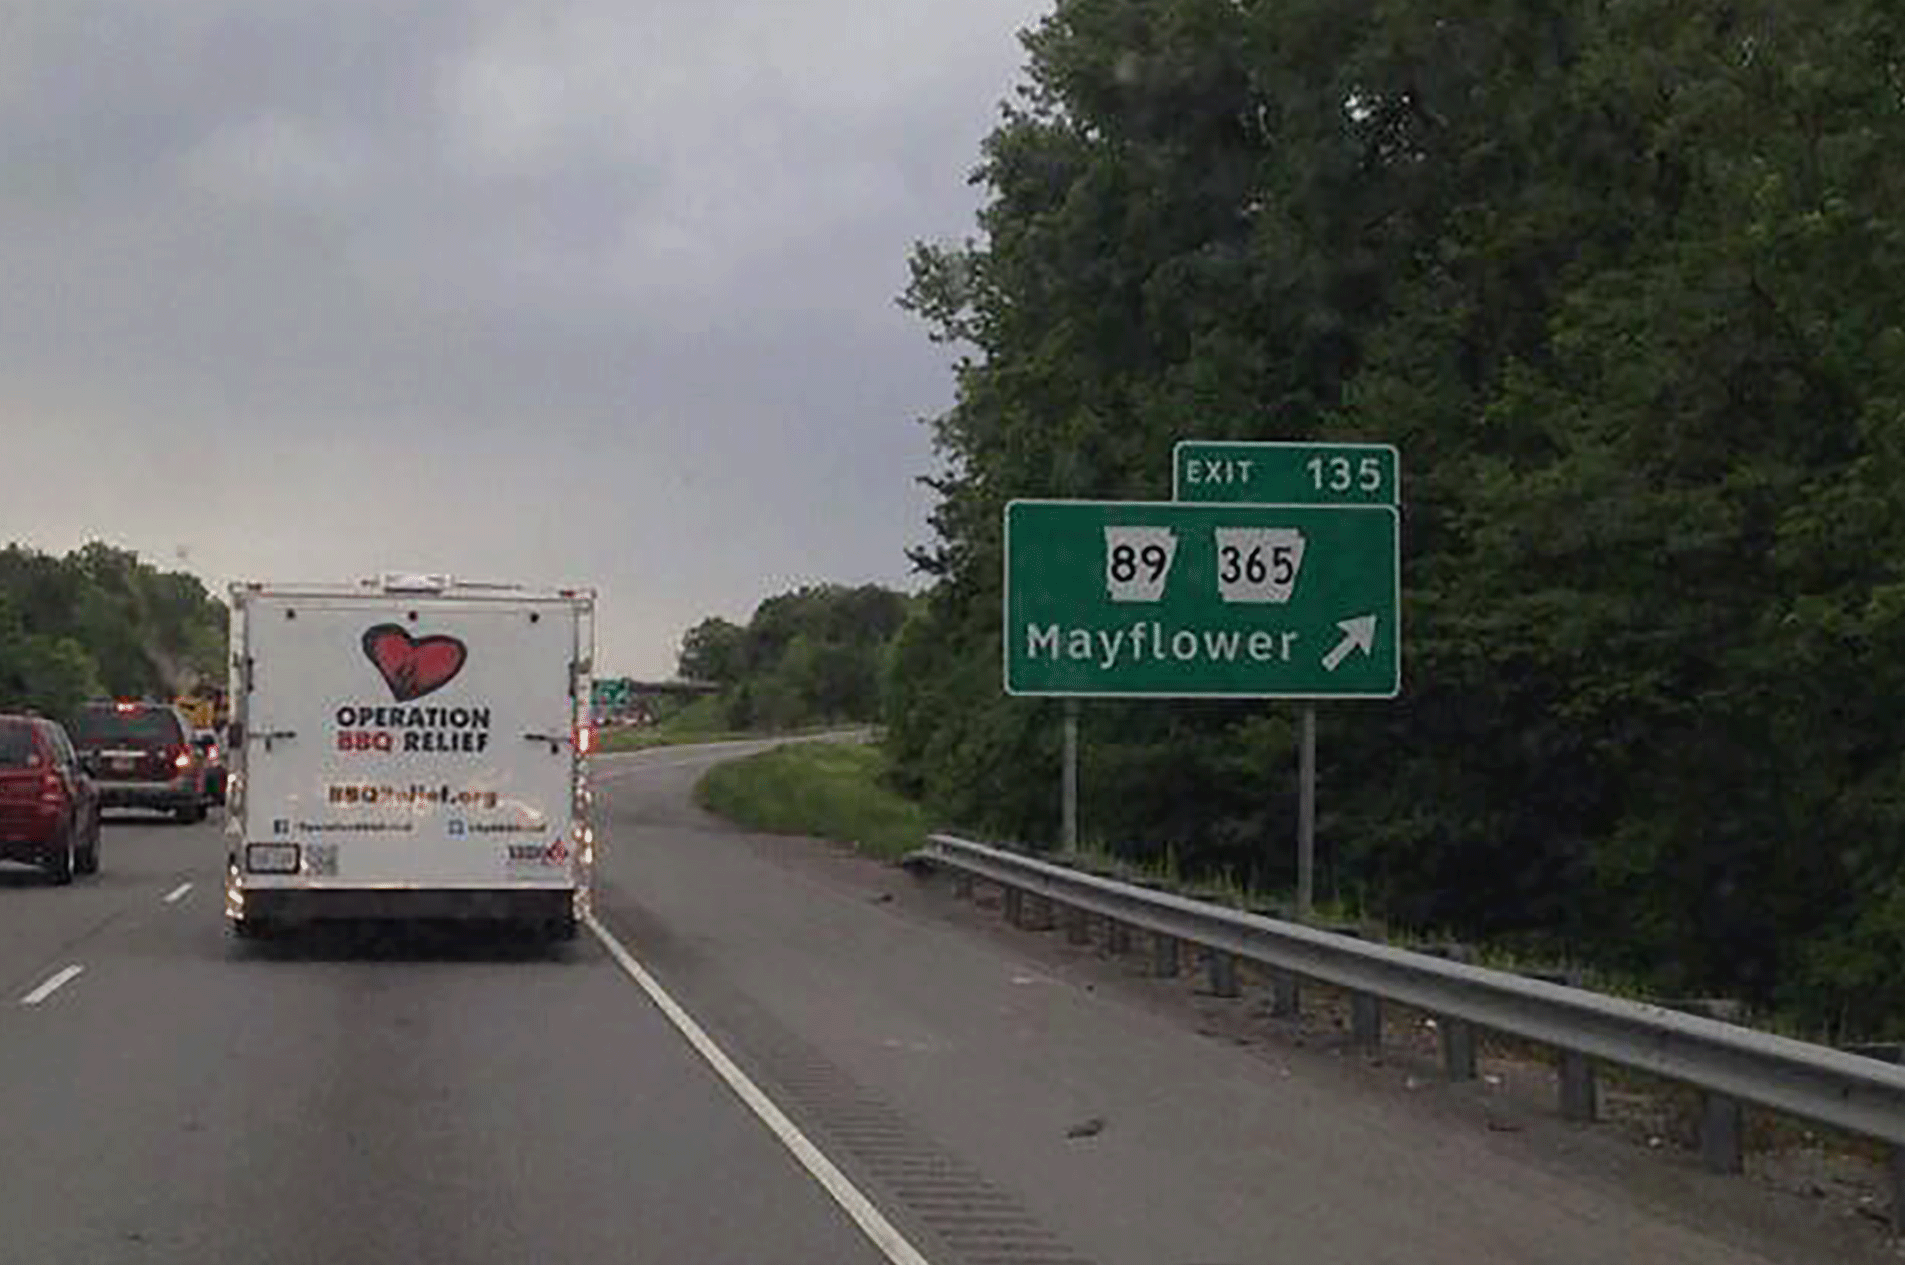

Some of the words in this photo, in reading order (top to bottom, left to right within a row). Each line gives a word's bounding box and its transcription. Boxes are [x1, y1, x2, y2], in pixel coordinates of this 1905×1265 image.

[1186, 460, 1254, 484] EXIT
[1306, 457, 1381, 491] 135
[1110, 545, 1167, 582] 89
[1220, 546, 1294, 584] 365
[1026, 622, 1298, 670] Mayflower
[336, 706, 490, 728] OPERATION
[337, 731, 393, 752] BBQ
[403, 731, 488, 752] RELIEF
